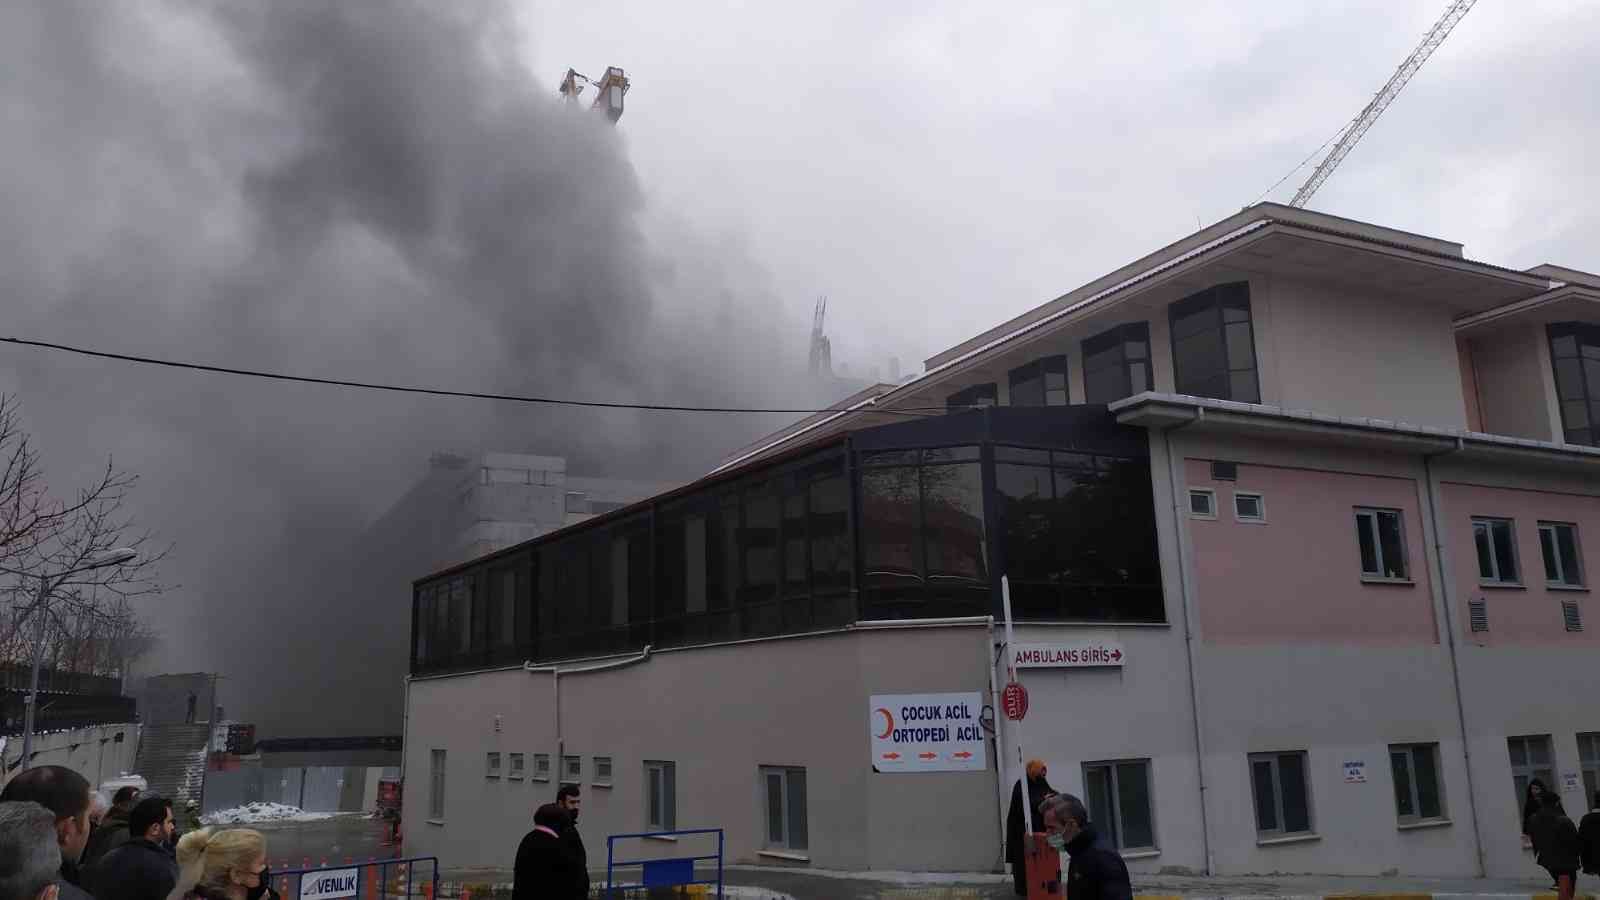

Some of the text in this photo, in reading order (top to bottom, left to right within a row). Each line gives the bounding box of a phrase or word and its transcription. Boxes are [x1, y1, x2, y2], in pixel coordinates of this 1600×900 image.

[1015, 646, 1110, 664] AMBULANS GİRİŞ
[1007, 687, 1017, 717] DUR
[902, 702, 971, 723] ÇOCUK ACİL
[892, 724, 983, 743] ORTOPEDİ ACİL
